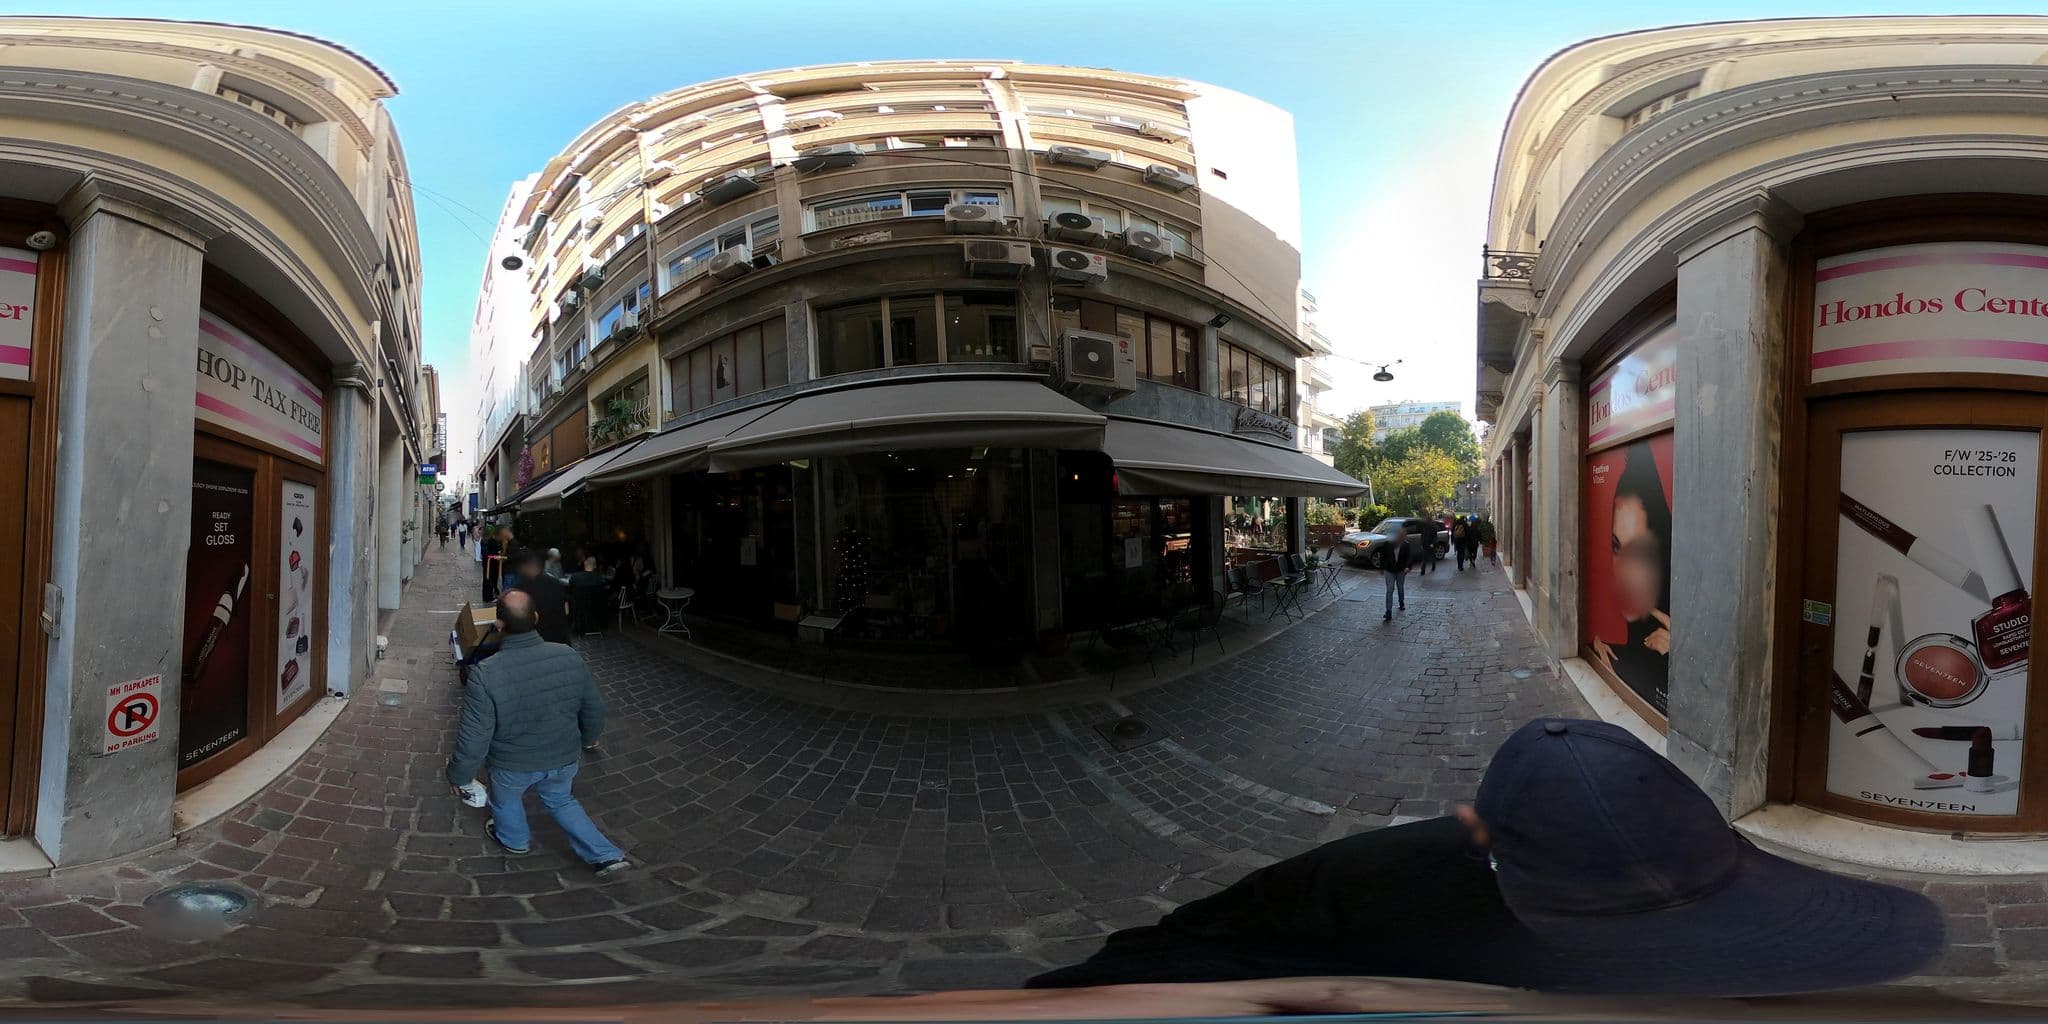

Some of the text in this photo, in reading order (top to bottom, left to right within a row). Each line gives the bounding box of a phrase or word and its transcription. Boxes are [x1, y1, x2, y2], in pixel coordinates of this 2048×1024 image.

[1817, 292, 1944, 328] Hondos
[251, 375, 287, 415] TAX
[290, 400, 321, 435] FREE
[1944, 449, 1972, 462] F/W
[1933, 464, 2016, 477] COLLECTION
[212, 511, 231, 519] READY
[214, 522, 229, 532] SET
[206, 534, 235, 546] GLOSS
[1993, 615, 2029, 633] STUDIO
[123, 675, 160, 693] ΠΑΡΚΑΡΕΤΕ
[125, 702, 148, 730] P
[107, 731, 157, 752] NO PARKING
